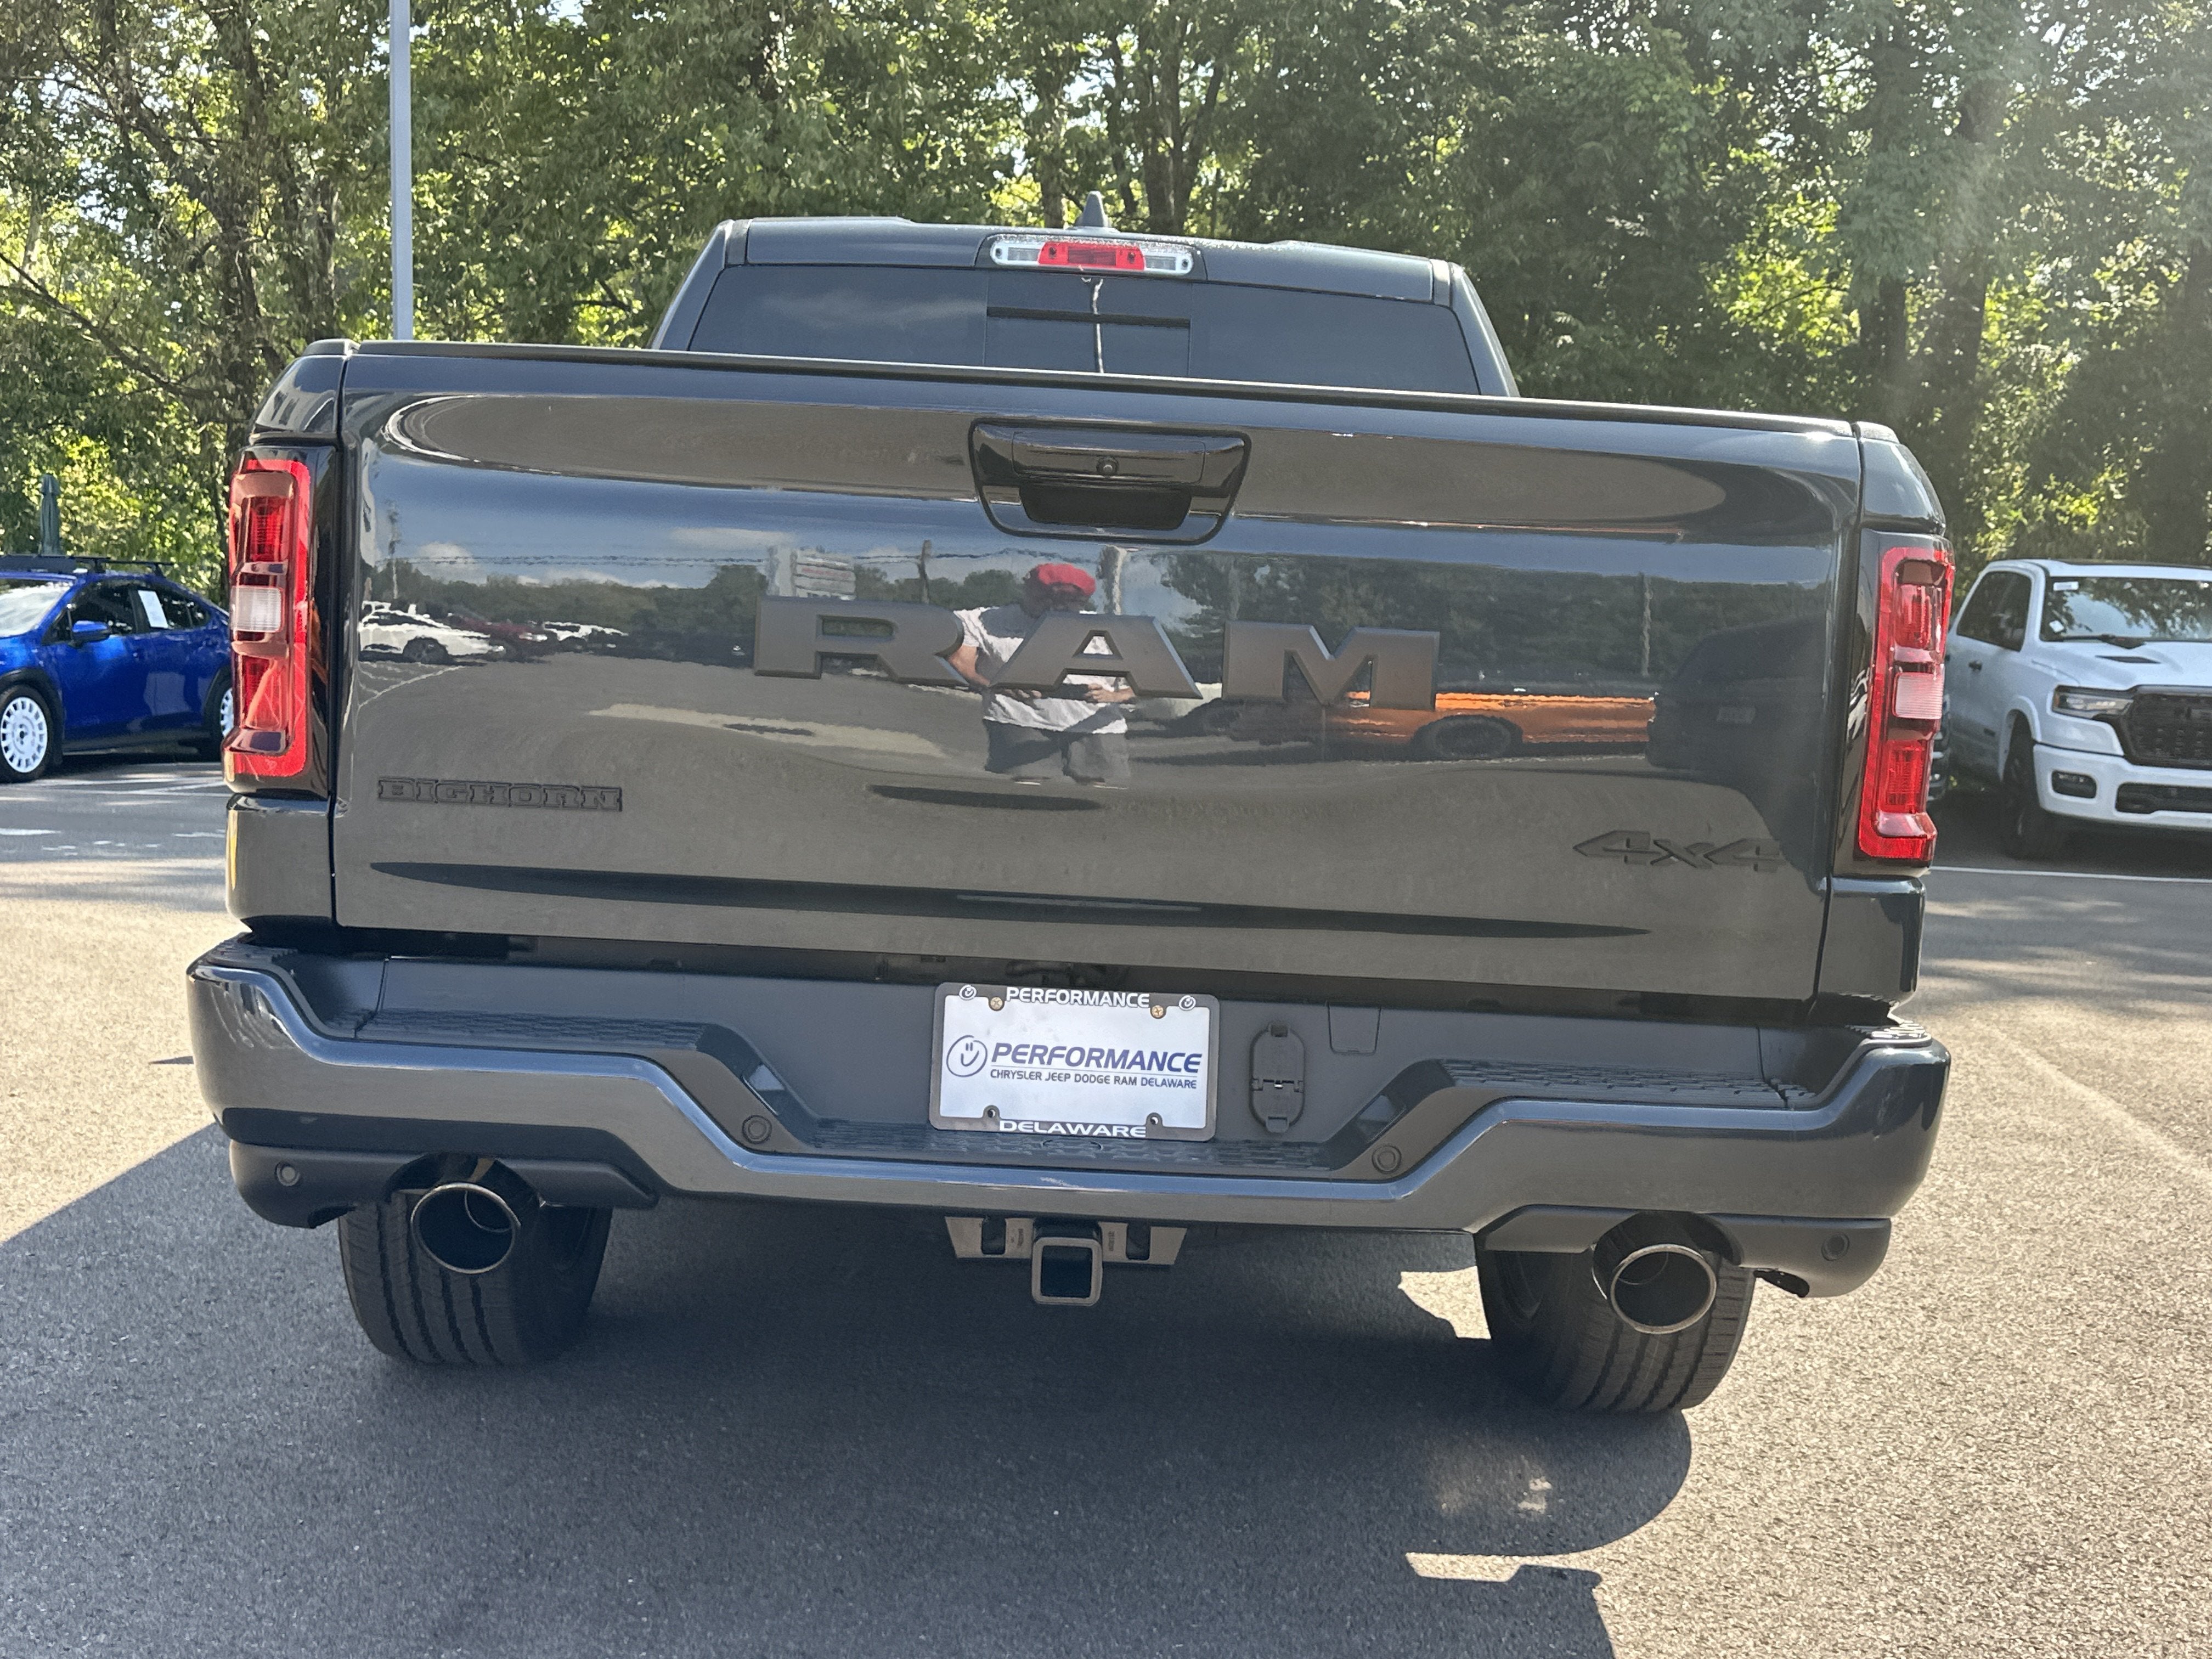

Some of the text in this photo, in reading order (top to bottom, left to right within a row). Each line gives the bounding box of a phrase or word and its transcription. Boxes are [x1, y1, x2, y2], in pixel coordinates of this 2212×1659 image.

[754, 595, 1440, 712] RAM
[378, 776, 623, 812] BIGHORN
[1006, 986, 1150, 1008] PERFORMANCE
[991, 1043, 1203, 1073] PERFORMANCE
[990, 1069, 1197, 1089] CHRYSLER JEEP DODGE RAM DELAWARE
[1000, 1120, 1147, 1137] DELAWARE
